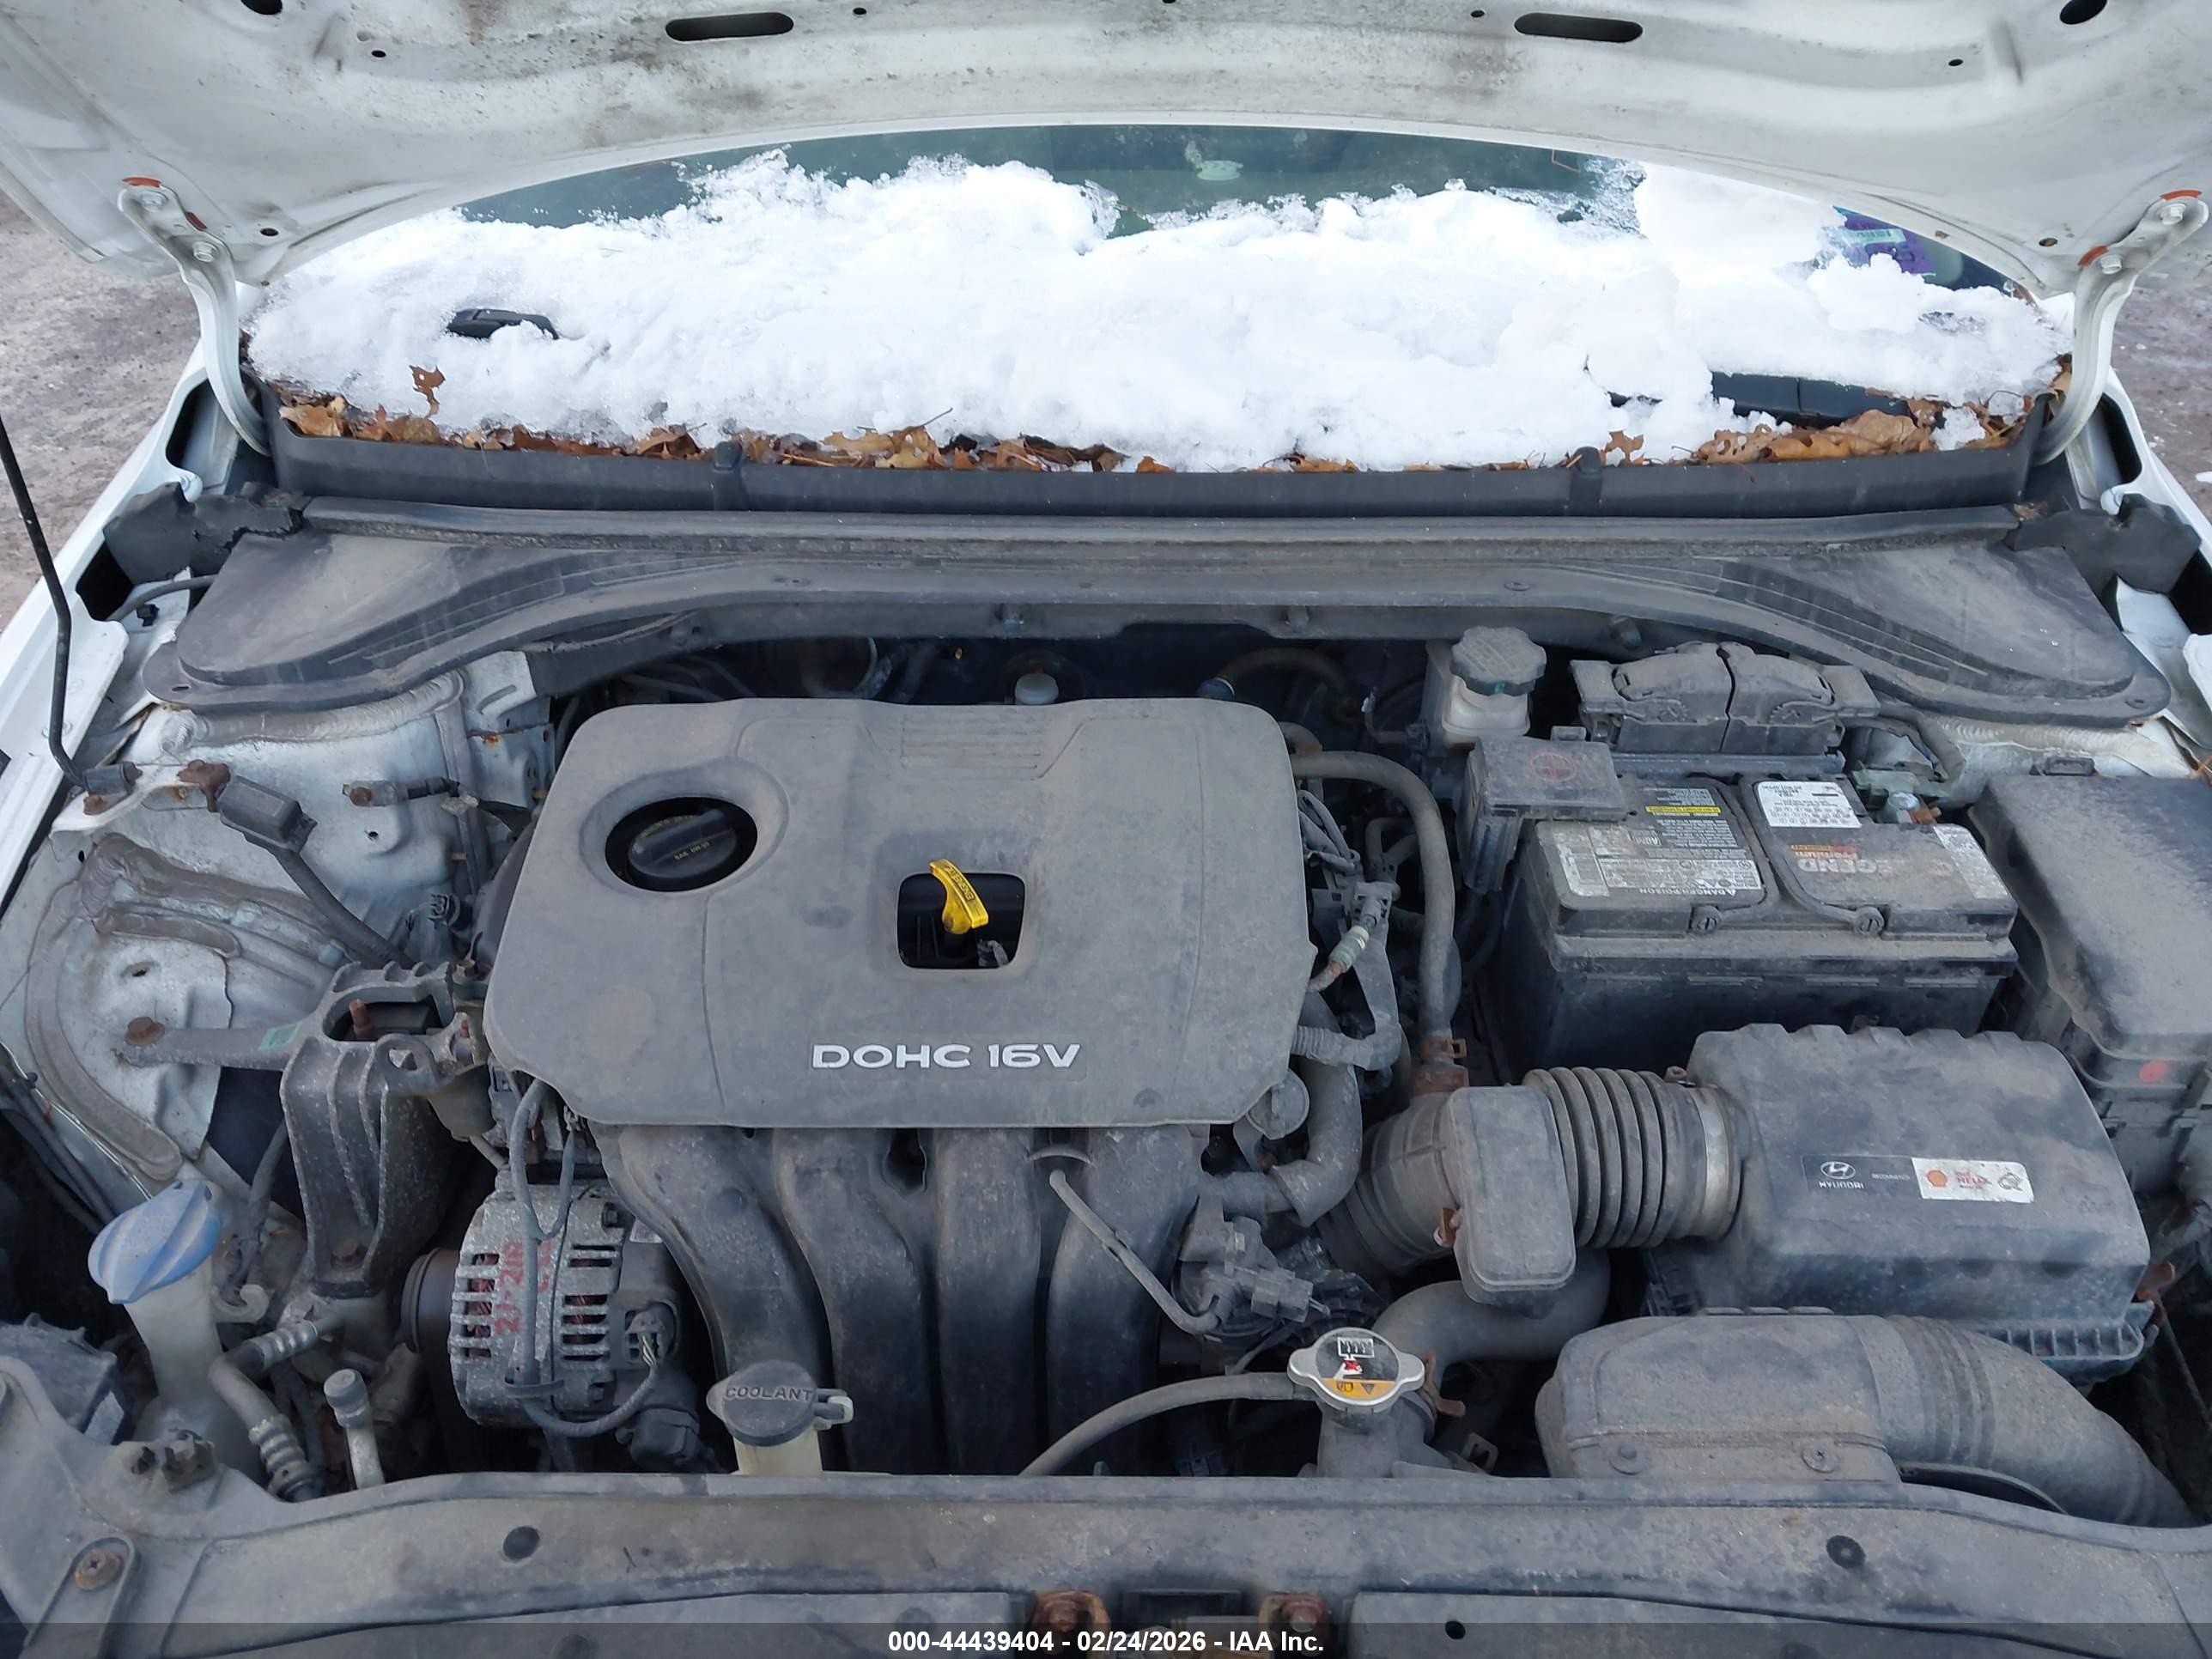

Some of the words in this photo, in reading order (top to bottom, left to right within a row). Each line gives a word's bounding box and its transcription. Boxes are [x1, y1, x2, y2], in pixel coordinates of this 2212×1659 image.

[811, 1043, 970, 1068] DOHC
[988, 1043, 1081, 1068] 16V
[1818, 1181, 1865, 1190] HYUNDAI
[723, 1386, 814, 1403] COOLANT
